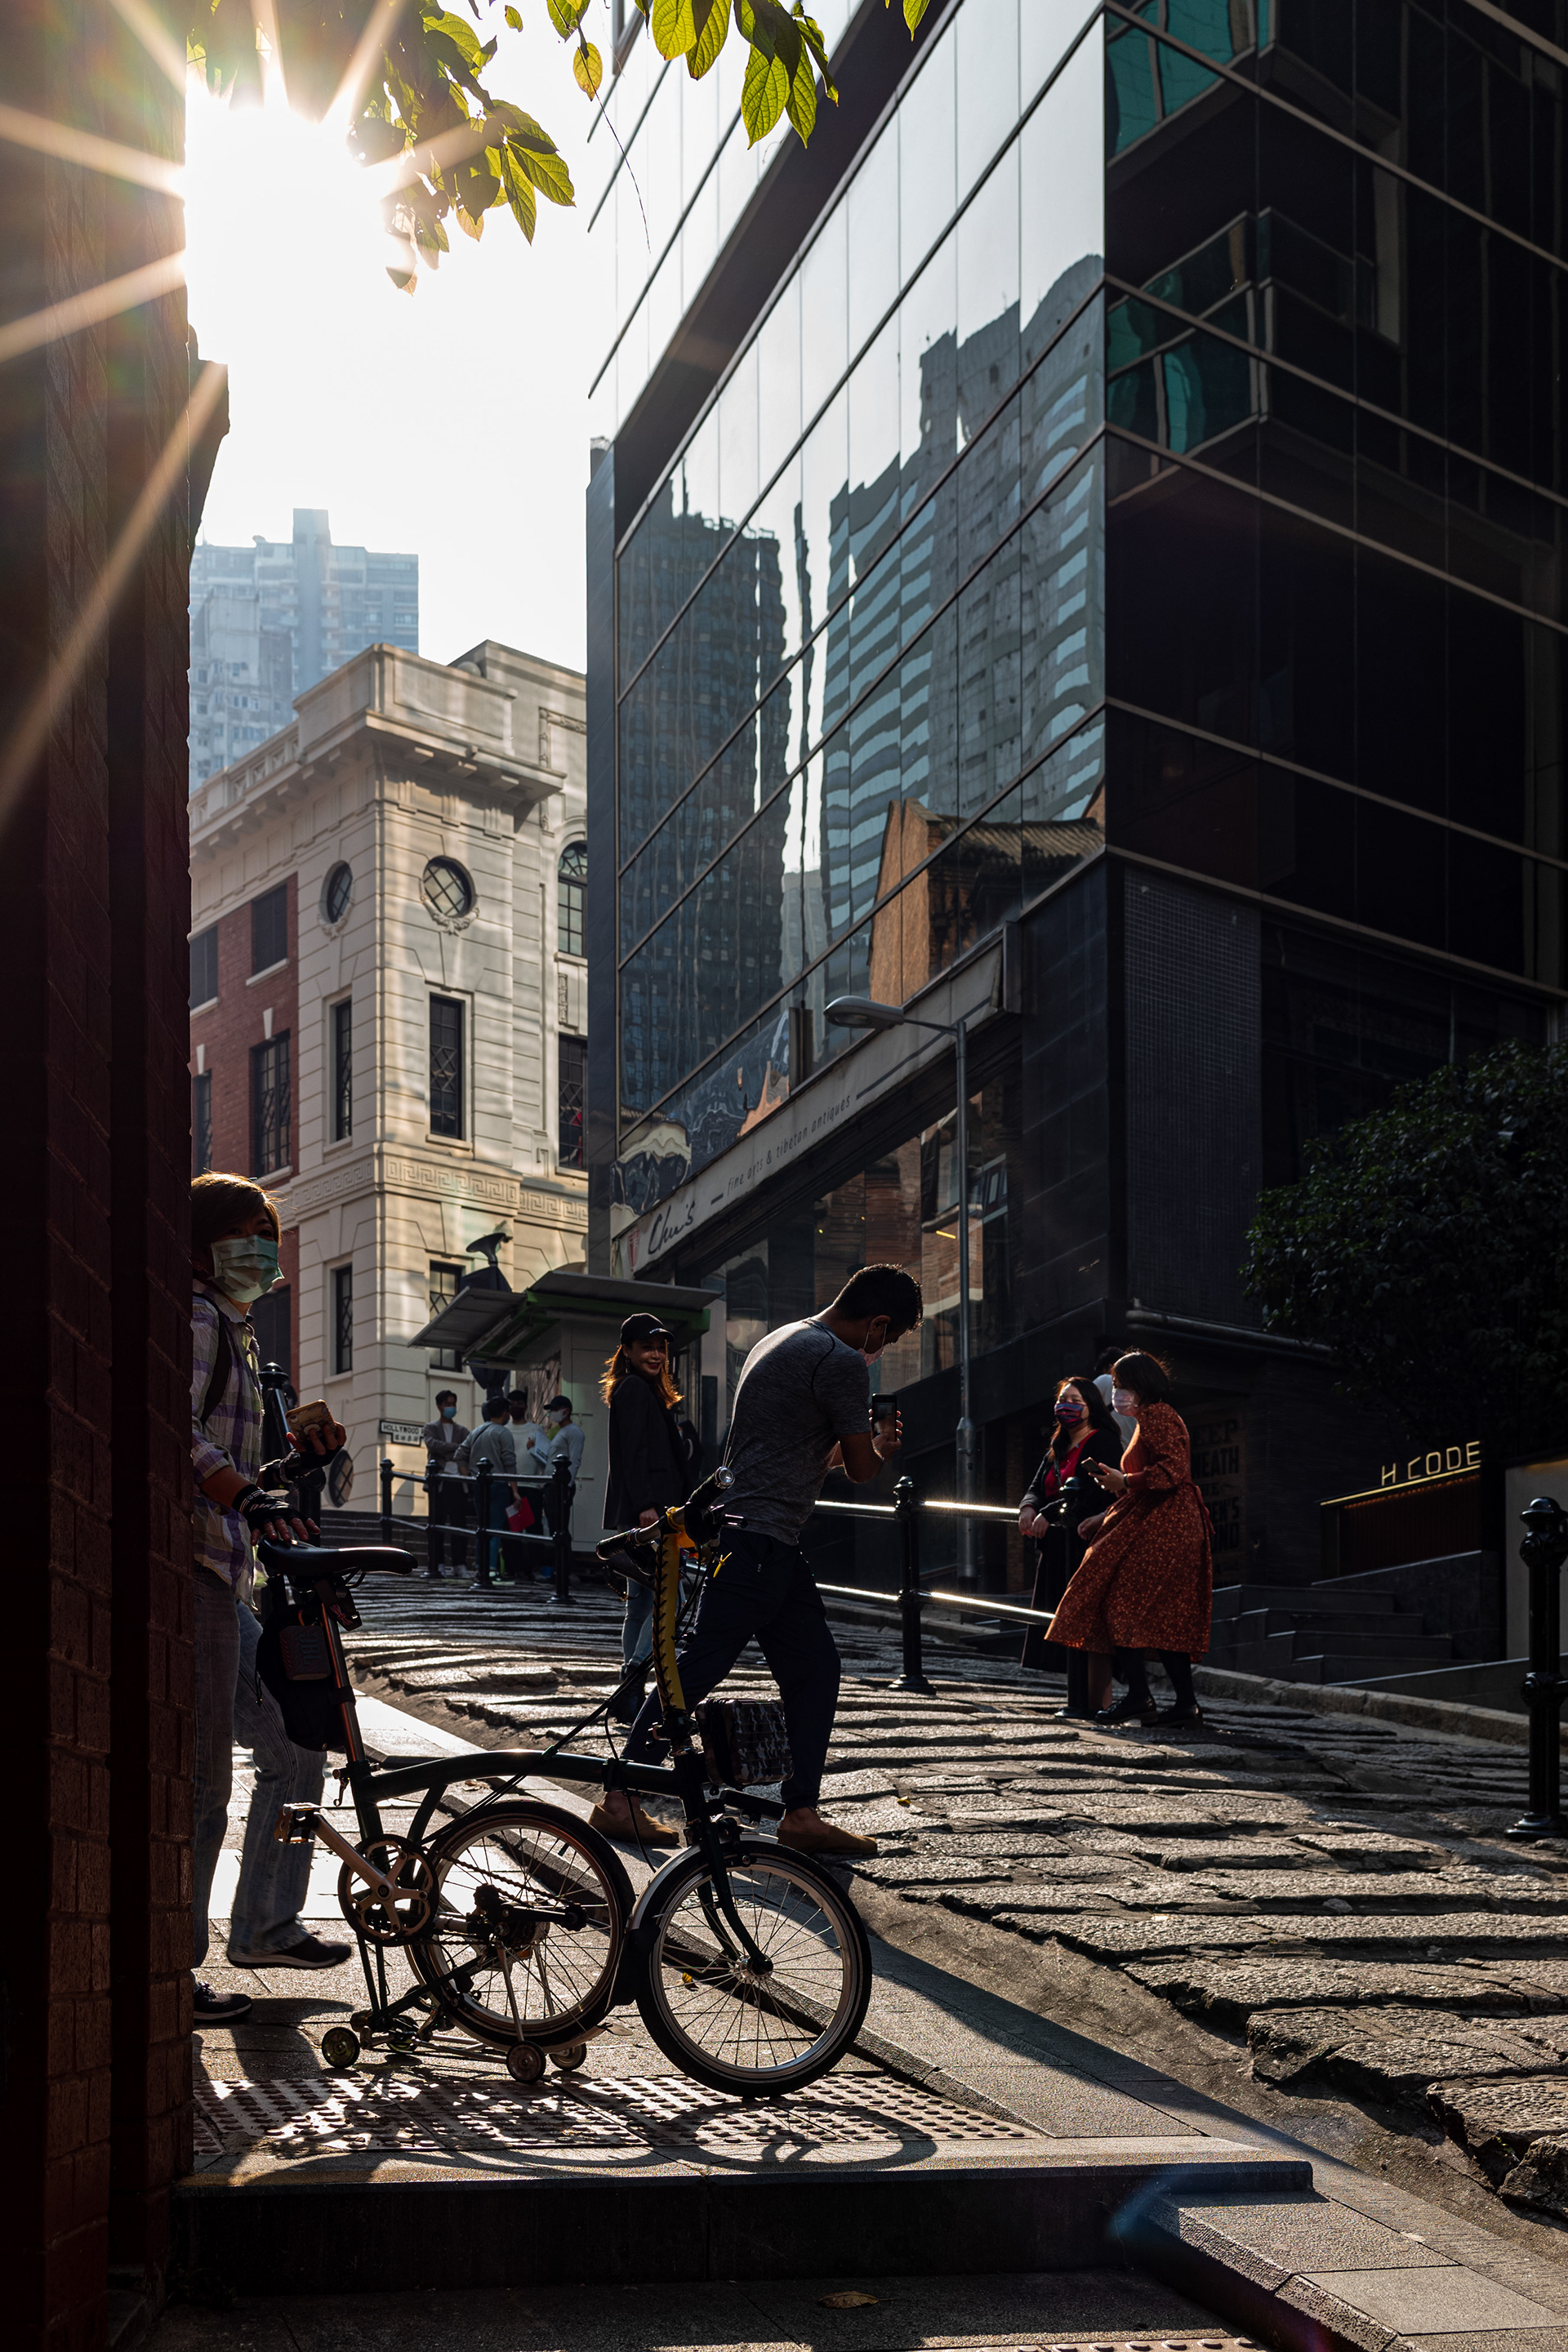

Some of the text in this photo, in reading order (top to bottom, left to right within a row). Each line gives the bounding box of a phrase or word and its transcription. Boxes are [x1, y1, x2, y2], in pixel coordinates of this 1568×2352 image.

[727, 1174, 744, 1196] fine
[747, 1159, 764, 1179] arts
[766, 1150, 773, 1165] &
[777, 1127, 808, 1158] tibetan
[811, 1095, 850, 1133] antiques
[383, 1424, 420, 1435] HOLLYWOOD
[1191, 1419, 1240, 1447] EEP
[1191, 1446, 1240, 1478] NEATH
[1381, 1441, 1481, 1486] H CODE
[299, 1633, 321, 1666] JBL
